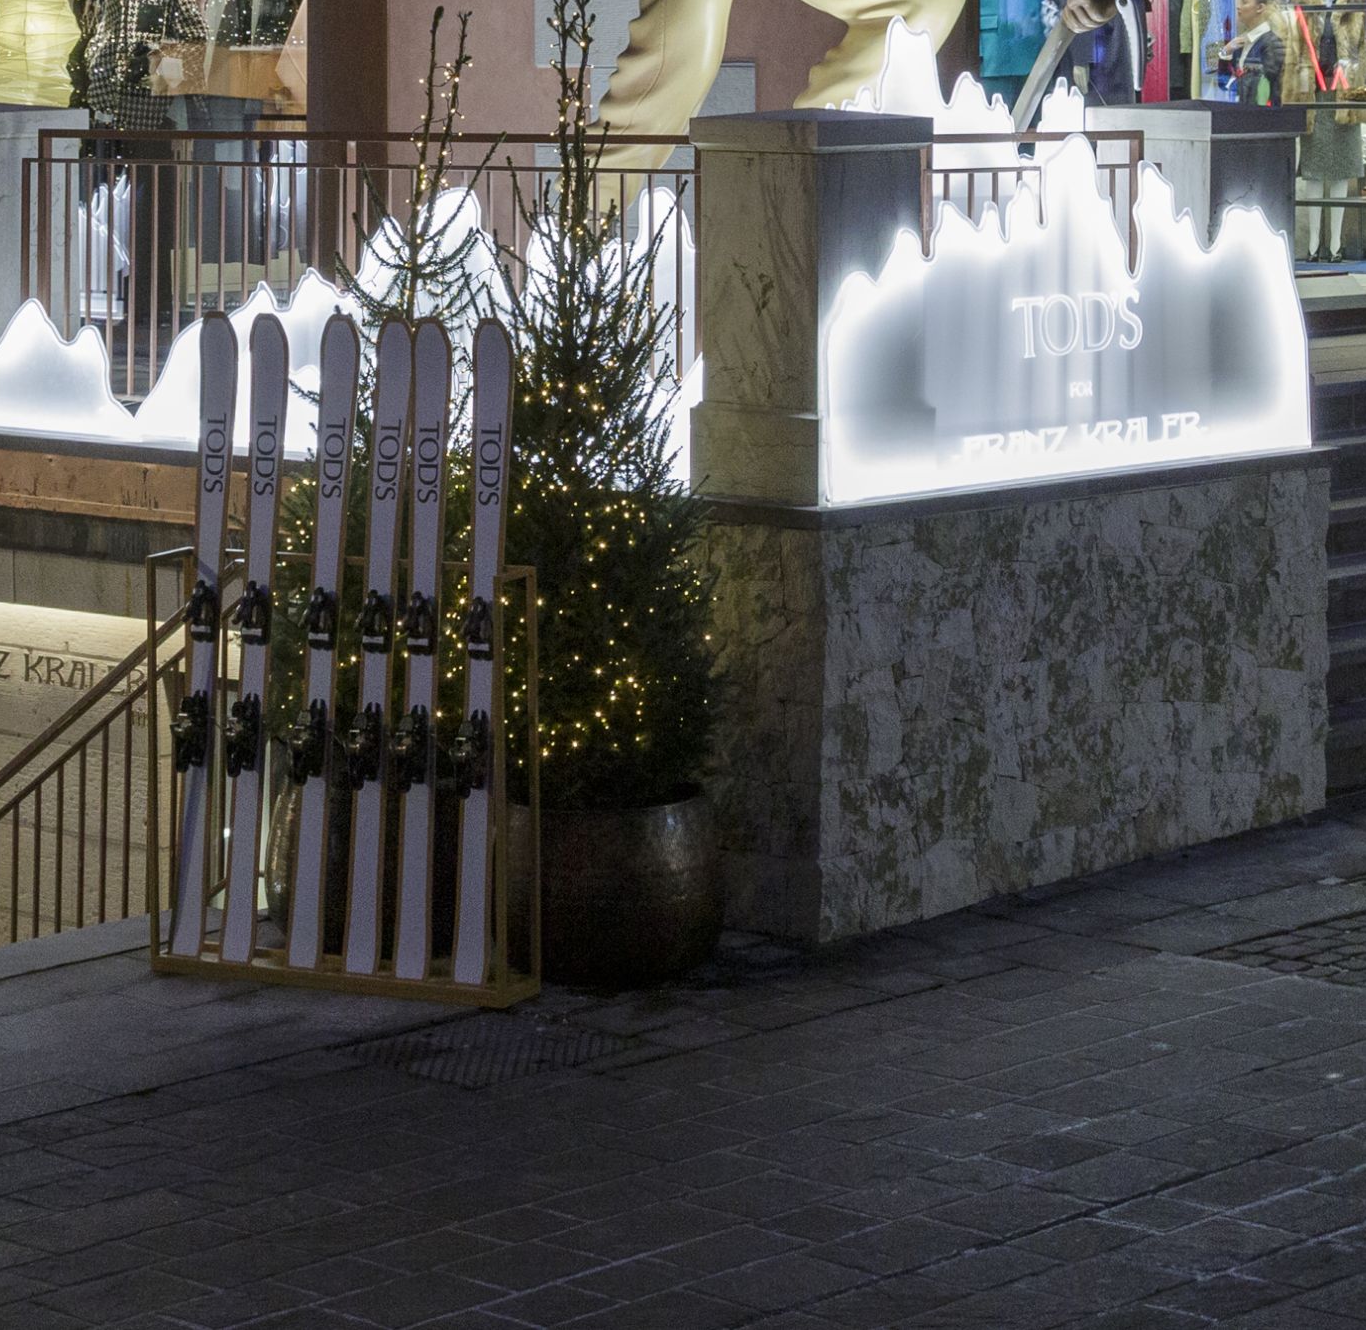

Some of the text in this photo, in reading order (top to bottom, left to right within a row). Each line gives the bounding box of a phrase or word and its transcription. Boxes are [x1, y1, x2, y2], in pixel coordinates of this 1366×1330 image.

[1012, 289, 1144, 359] TOD'S
[1070, 380, 1093, 399] FOR
[1081, 411, 1202, 446] KRALER
[203, 413, 227, 494] TOD'S
[253, 415, 277, 497] TOD'S
[321, 417, 346, 499] TOD'S
[375, 419, 401, 501] TOD'S
[417, 421, 440, 504] TOD'S
[478, 423, 502, 506] TOD'S
